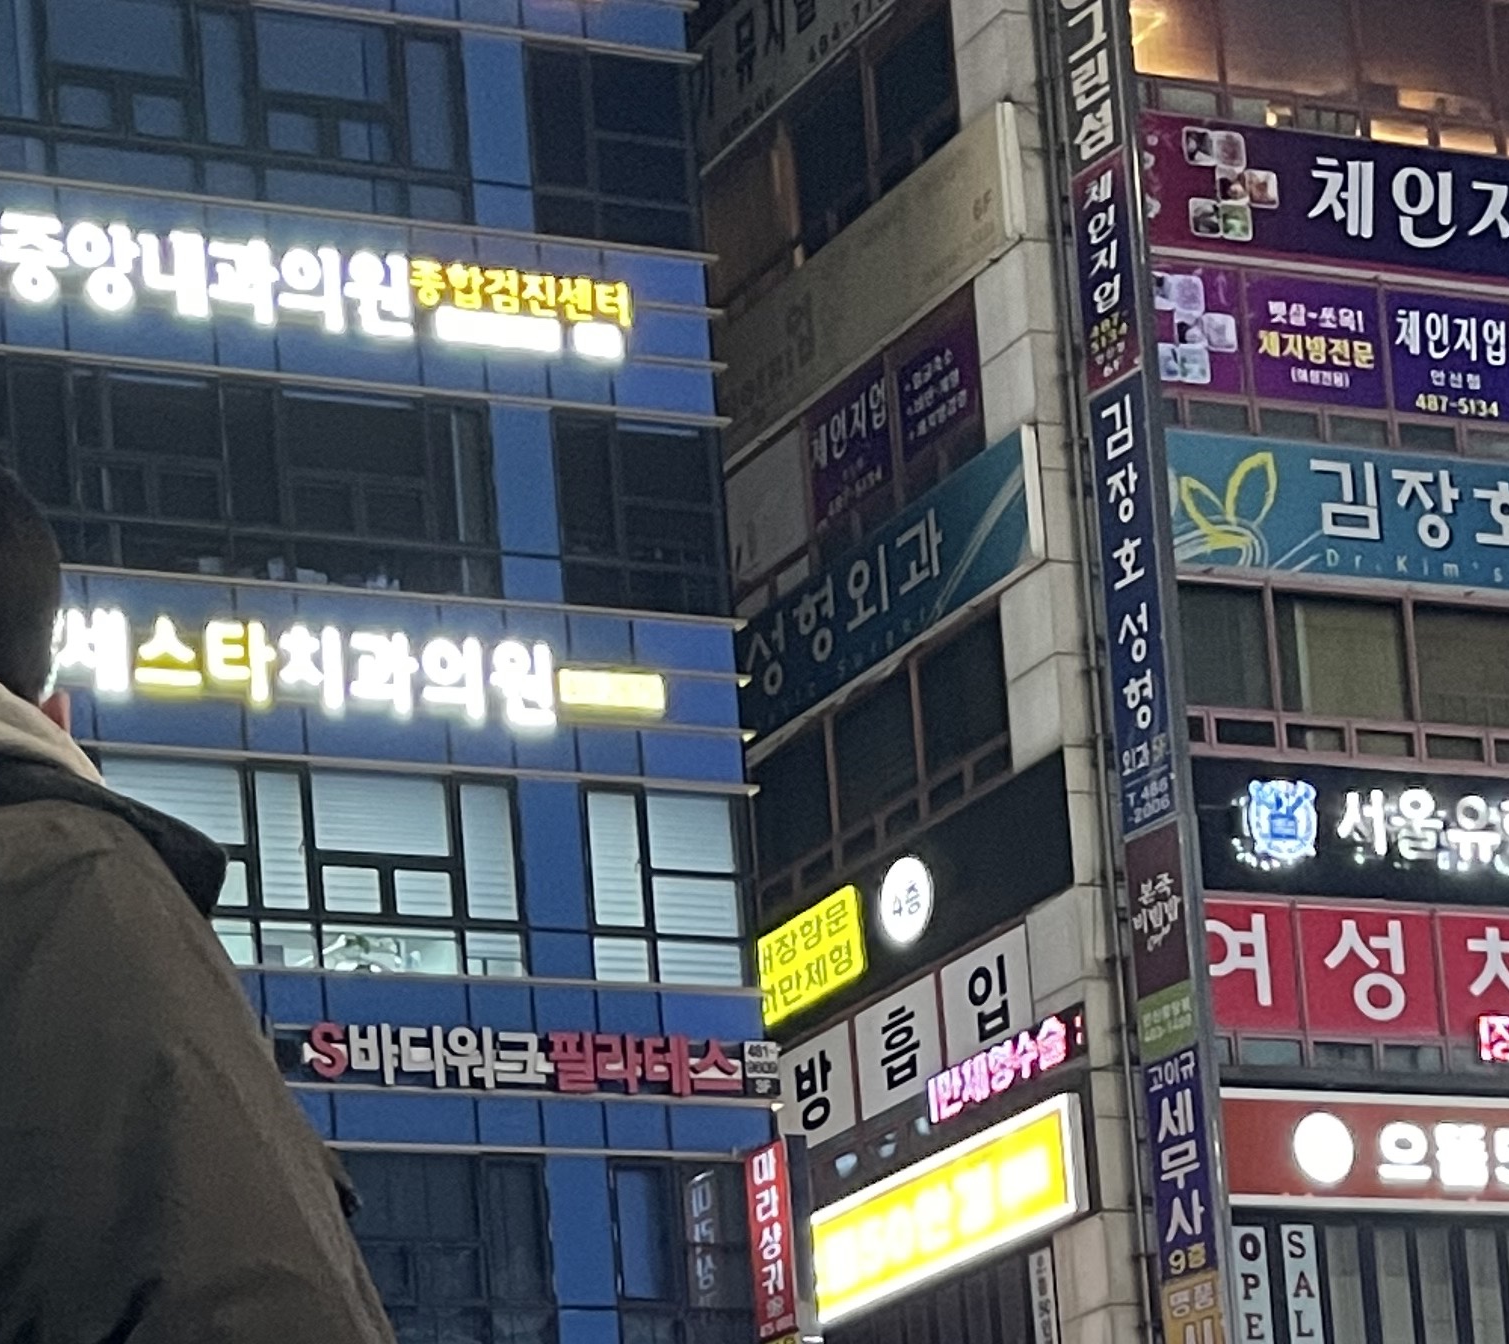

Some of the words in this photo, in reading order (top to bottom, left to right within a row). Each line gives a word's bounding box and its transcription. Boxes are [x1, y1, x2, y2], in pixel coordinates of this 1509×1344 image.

[1082, 169, 1122, 314] 체인지업
[411, 257, 634, 325] 종합검진센터
[1258, 330, 1375, 369] 체지방전문
[1395, 309, 1507, 366] 체인지업
[1416, 393, 1500, 418] 487-5134
[746, 507, 943, 695] 성형외과
[46, 607, 558, 727] 세스타치과의원
[1338, 788, 1509, 862] 서울유
[1147, 1050, 1196, 1093] 고이규
[1157, 1087, 1206, 1244] 세무사
